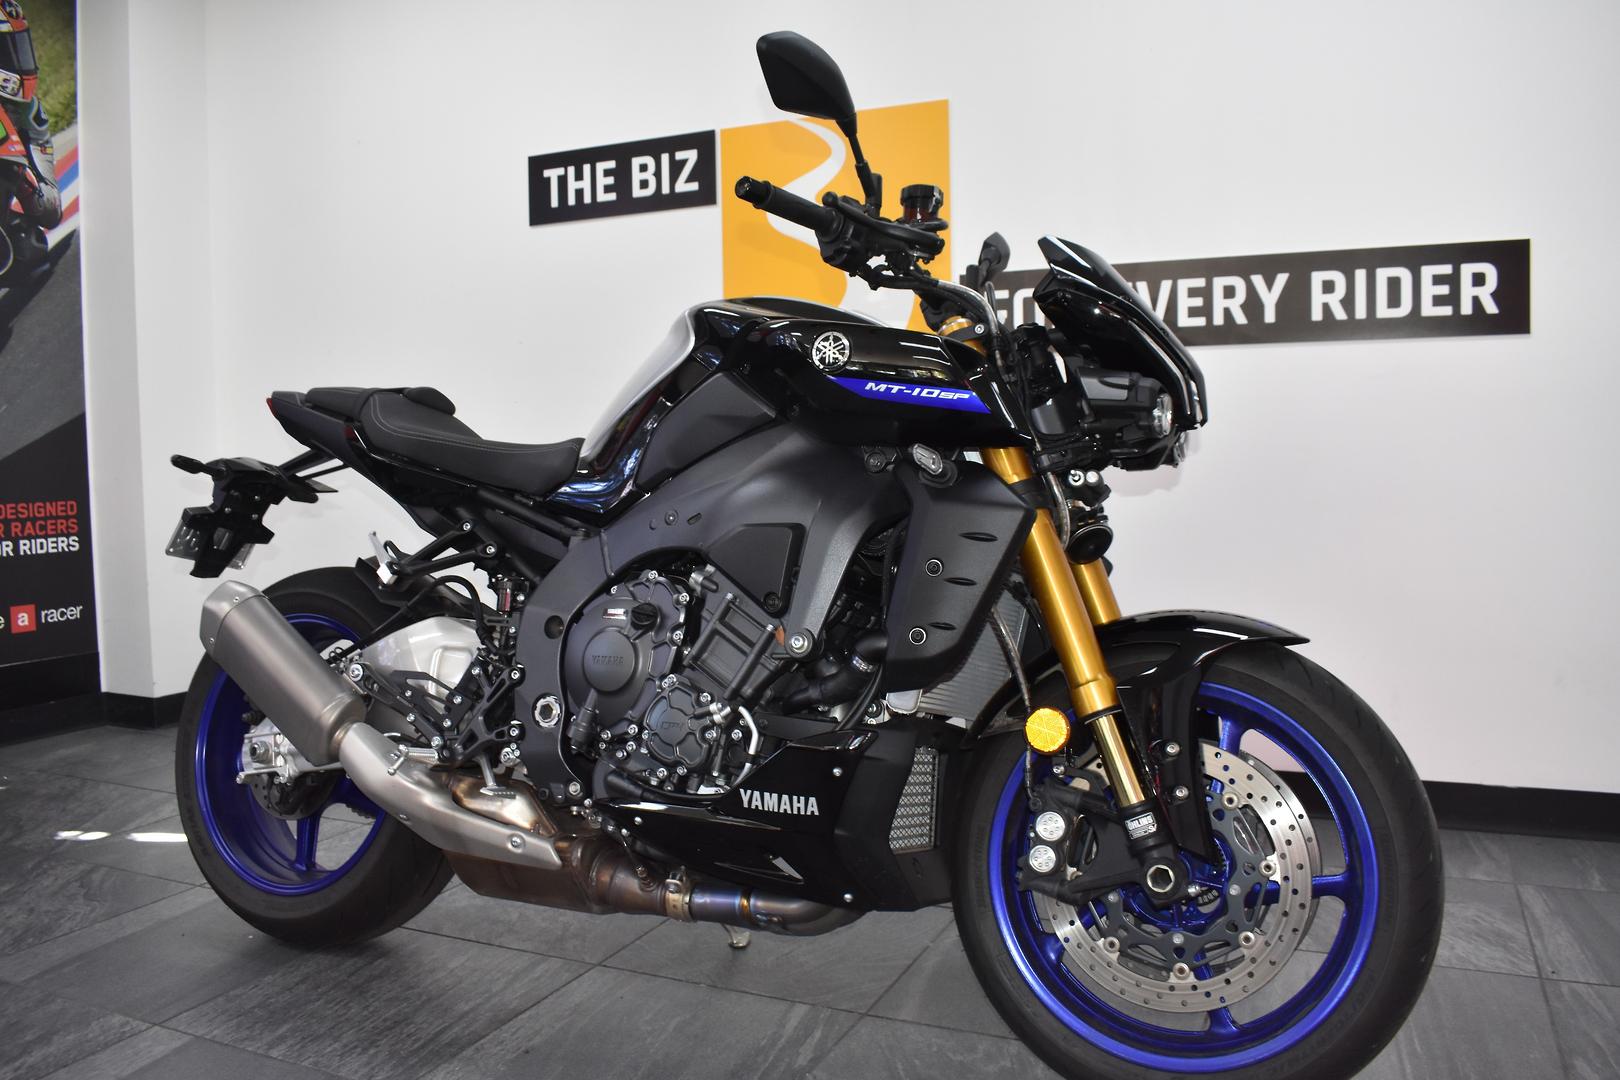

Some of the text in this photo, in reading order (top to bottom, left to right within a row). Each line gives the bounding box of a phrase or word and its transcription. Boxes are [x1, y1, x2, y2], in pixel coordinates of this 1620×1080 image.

[543, 149, 699, 208] THE BIZ
[1127, 273, 1290, 328] VERY
[1311, 262, 1500, 321] RIDER
[11, 518, 79, 537] RACERS
[19, 536, 80, 556] RIDERS
[17, 612, 29, 626] a
[41, 606, 83, 623] racer
[740, 789, 819, 816] YAMAHA
